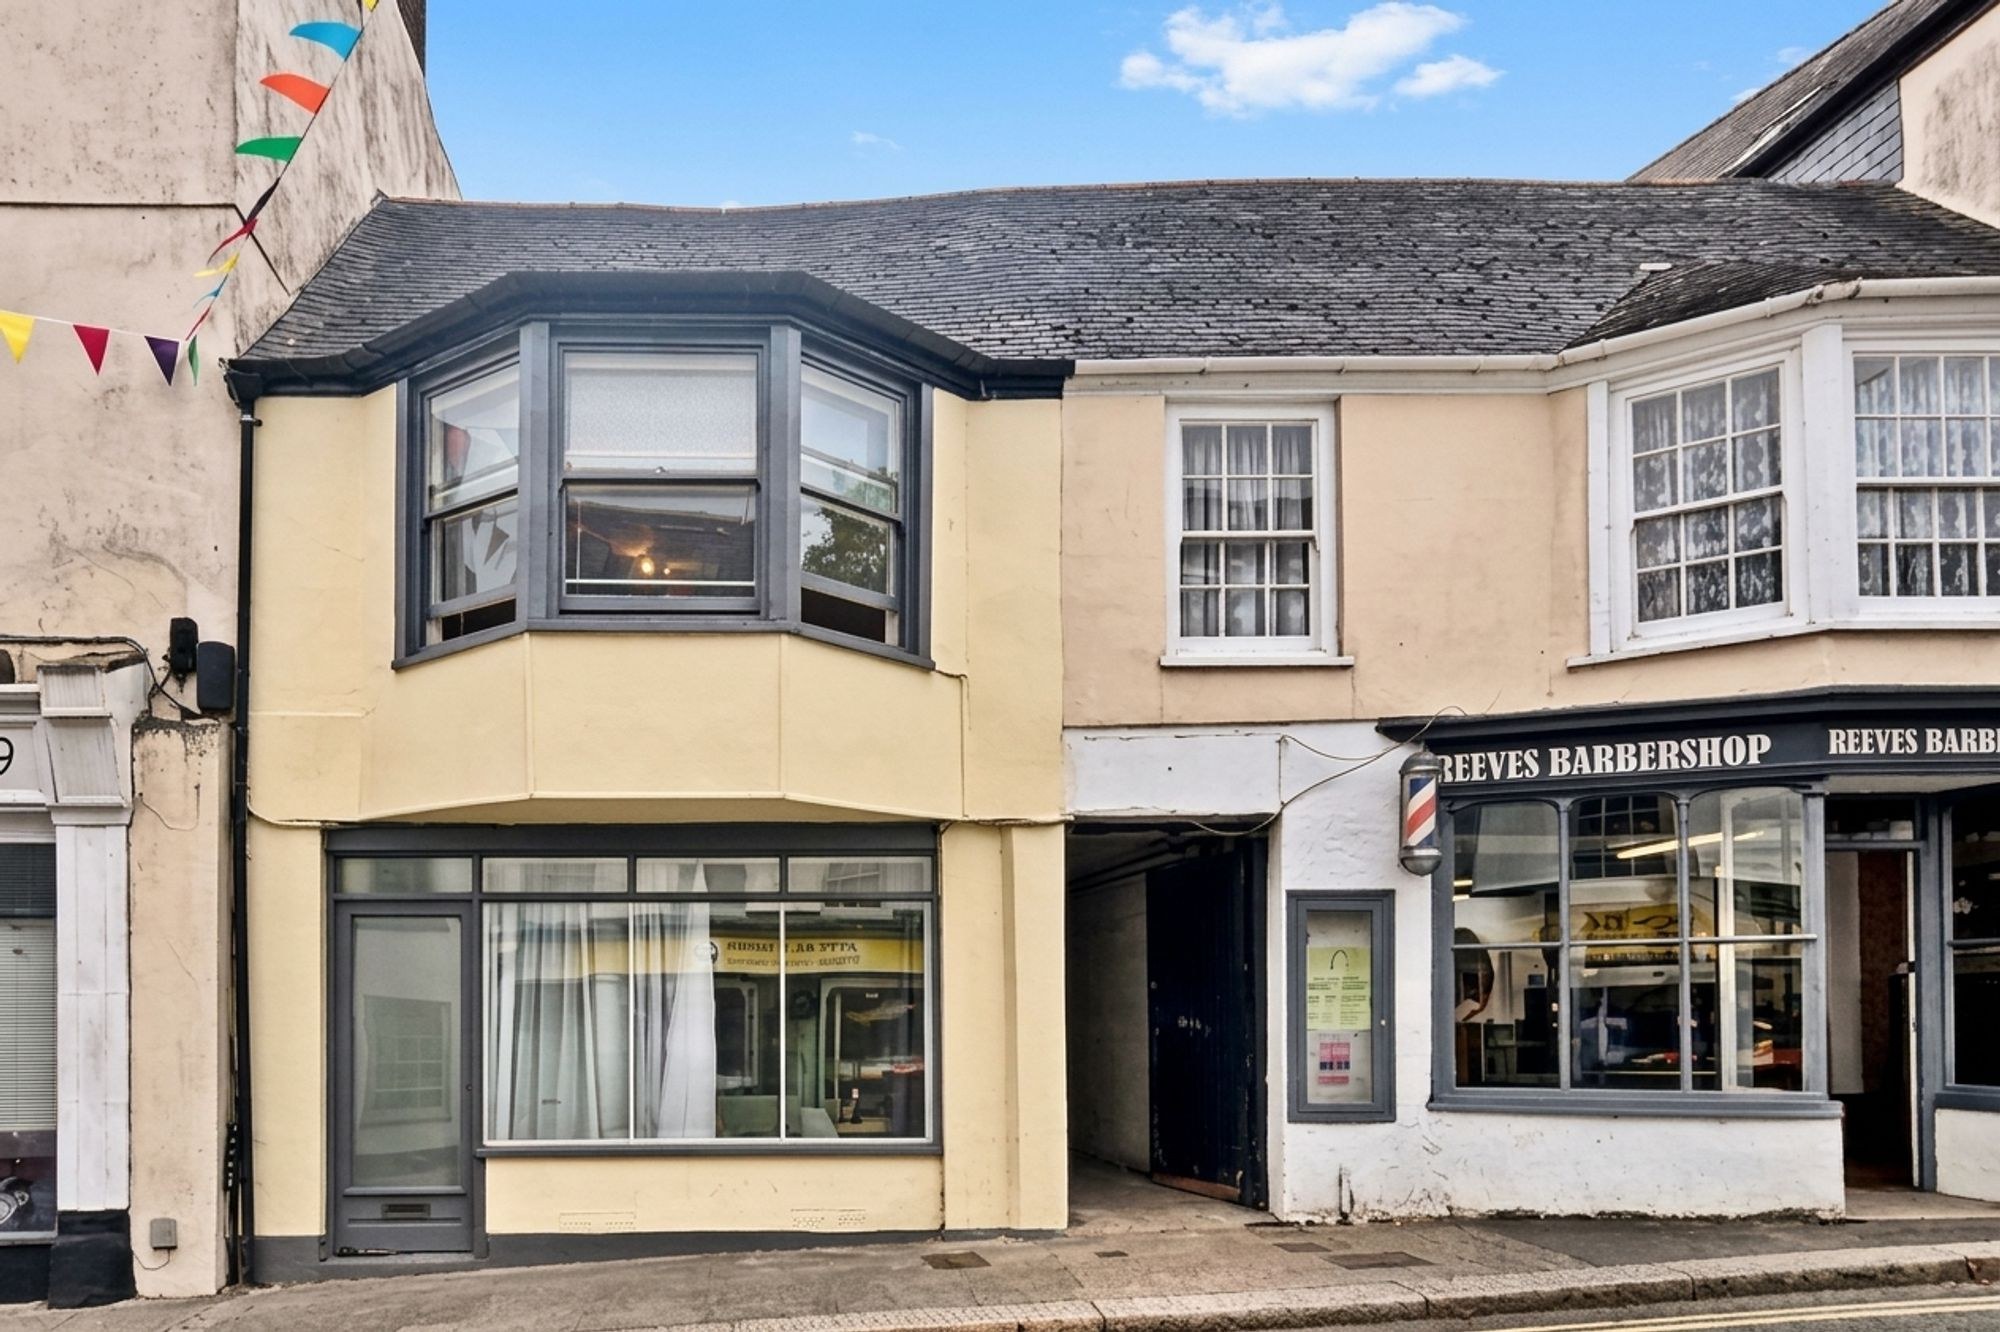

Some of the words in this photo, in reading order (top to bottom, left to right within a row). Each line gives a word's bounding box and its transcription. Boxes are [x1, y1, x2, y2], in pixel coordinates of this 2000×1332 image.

[1438, 748, 1541, 784] REEVES
[1548, 733, 1772, 777] BARBERSHOP
[1828, 728, 1918, 755] REEVES
[1925, 728, 2000, 754] BARB
